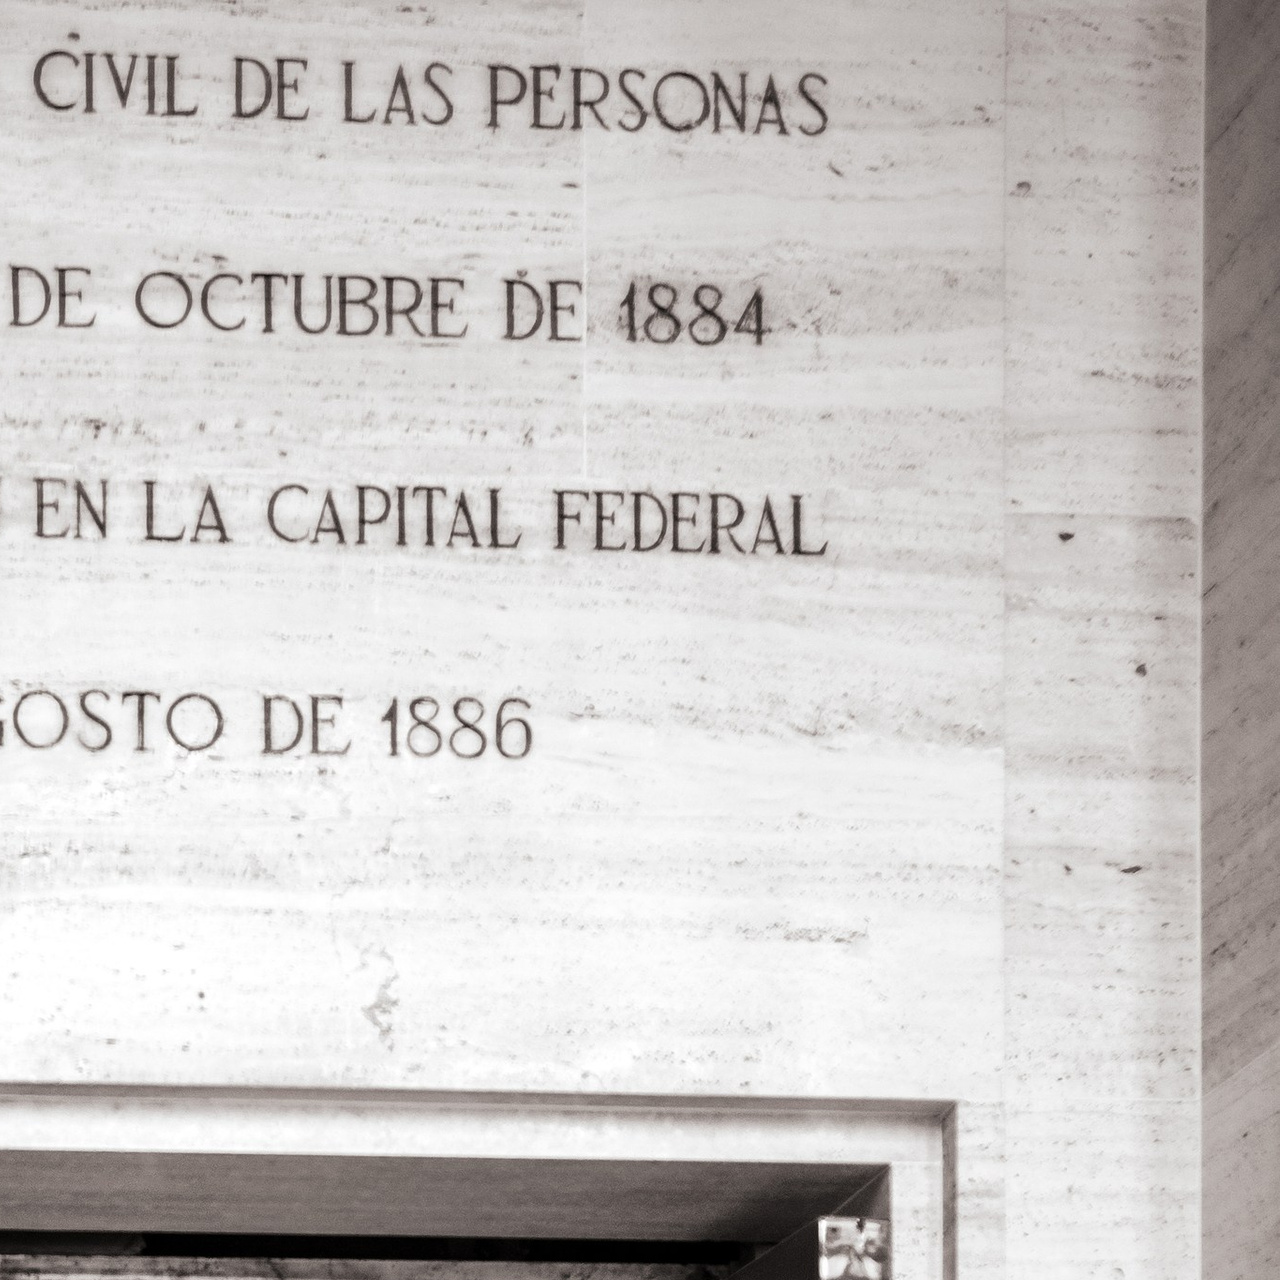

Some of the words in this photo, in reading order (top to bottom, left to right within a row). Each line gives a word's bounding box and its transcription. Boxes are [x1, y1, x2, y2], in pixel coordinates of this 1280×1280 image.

[33, 49, 198, 119] CIVIL
[232, 56, 310, 121] DE
[342, 60, 454, 127] LAS
[486, 64, 830, 136] PERSONAS
[8, 265, 95, 329] DE
[134, 270, 468, 340] OCTUBRE
[504, 278, 583, 342] DE
[619, 283, 772, 346] 1884
[33, 476, 108, 539] EN
[144, 479, 233, 544] LA
[267, 483, 522, 549] CAPITAL
[552, 489, 828, 556] FEDERAL
[261, 693, 351, 756] DE
[382, 695, 534, 760] 1886
